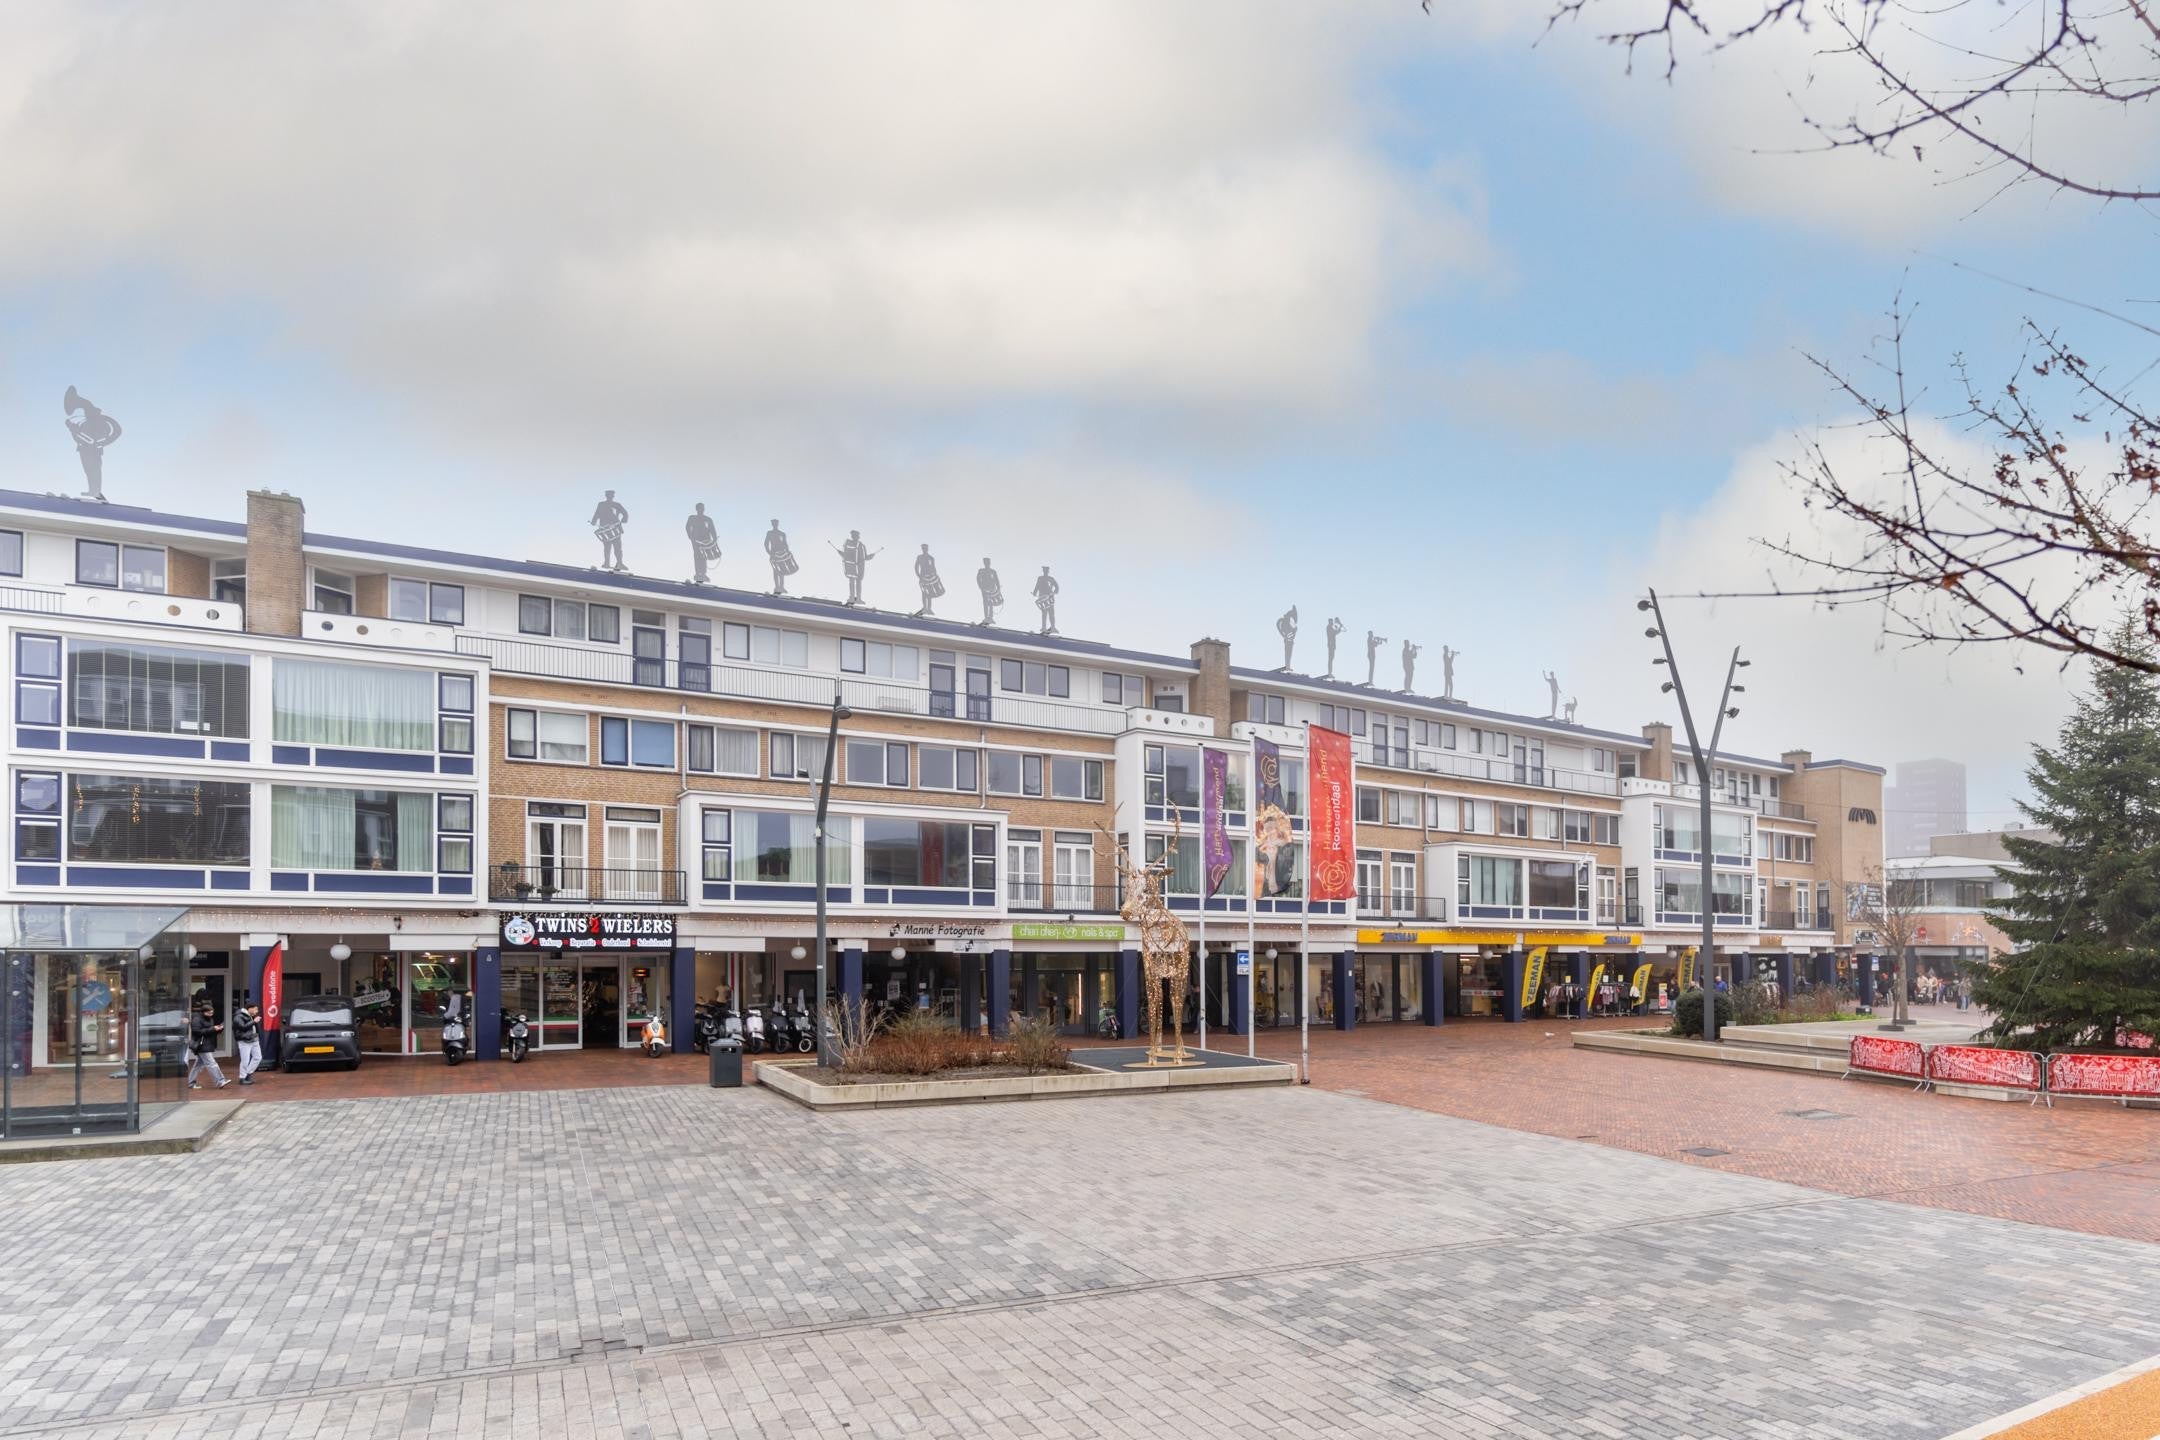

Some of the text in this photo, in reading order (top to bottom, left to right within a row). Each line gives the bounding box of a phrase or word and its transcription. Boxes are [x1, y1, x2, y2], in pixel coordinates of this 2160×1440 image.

[1330, 780, 1342, 851] Roosendaal
[590, 917, 600, 933] 2
[904, 925, 985, 937] Manné Fotografie
[269, 970, 277, 1004] vodafone
[1526, 955, 1542, 1002] ZEEMAN
